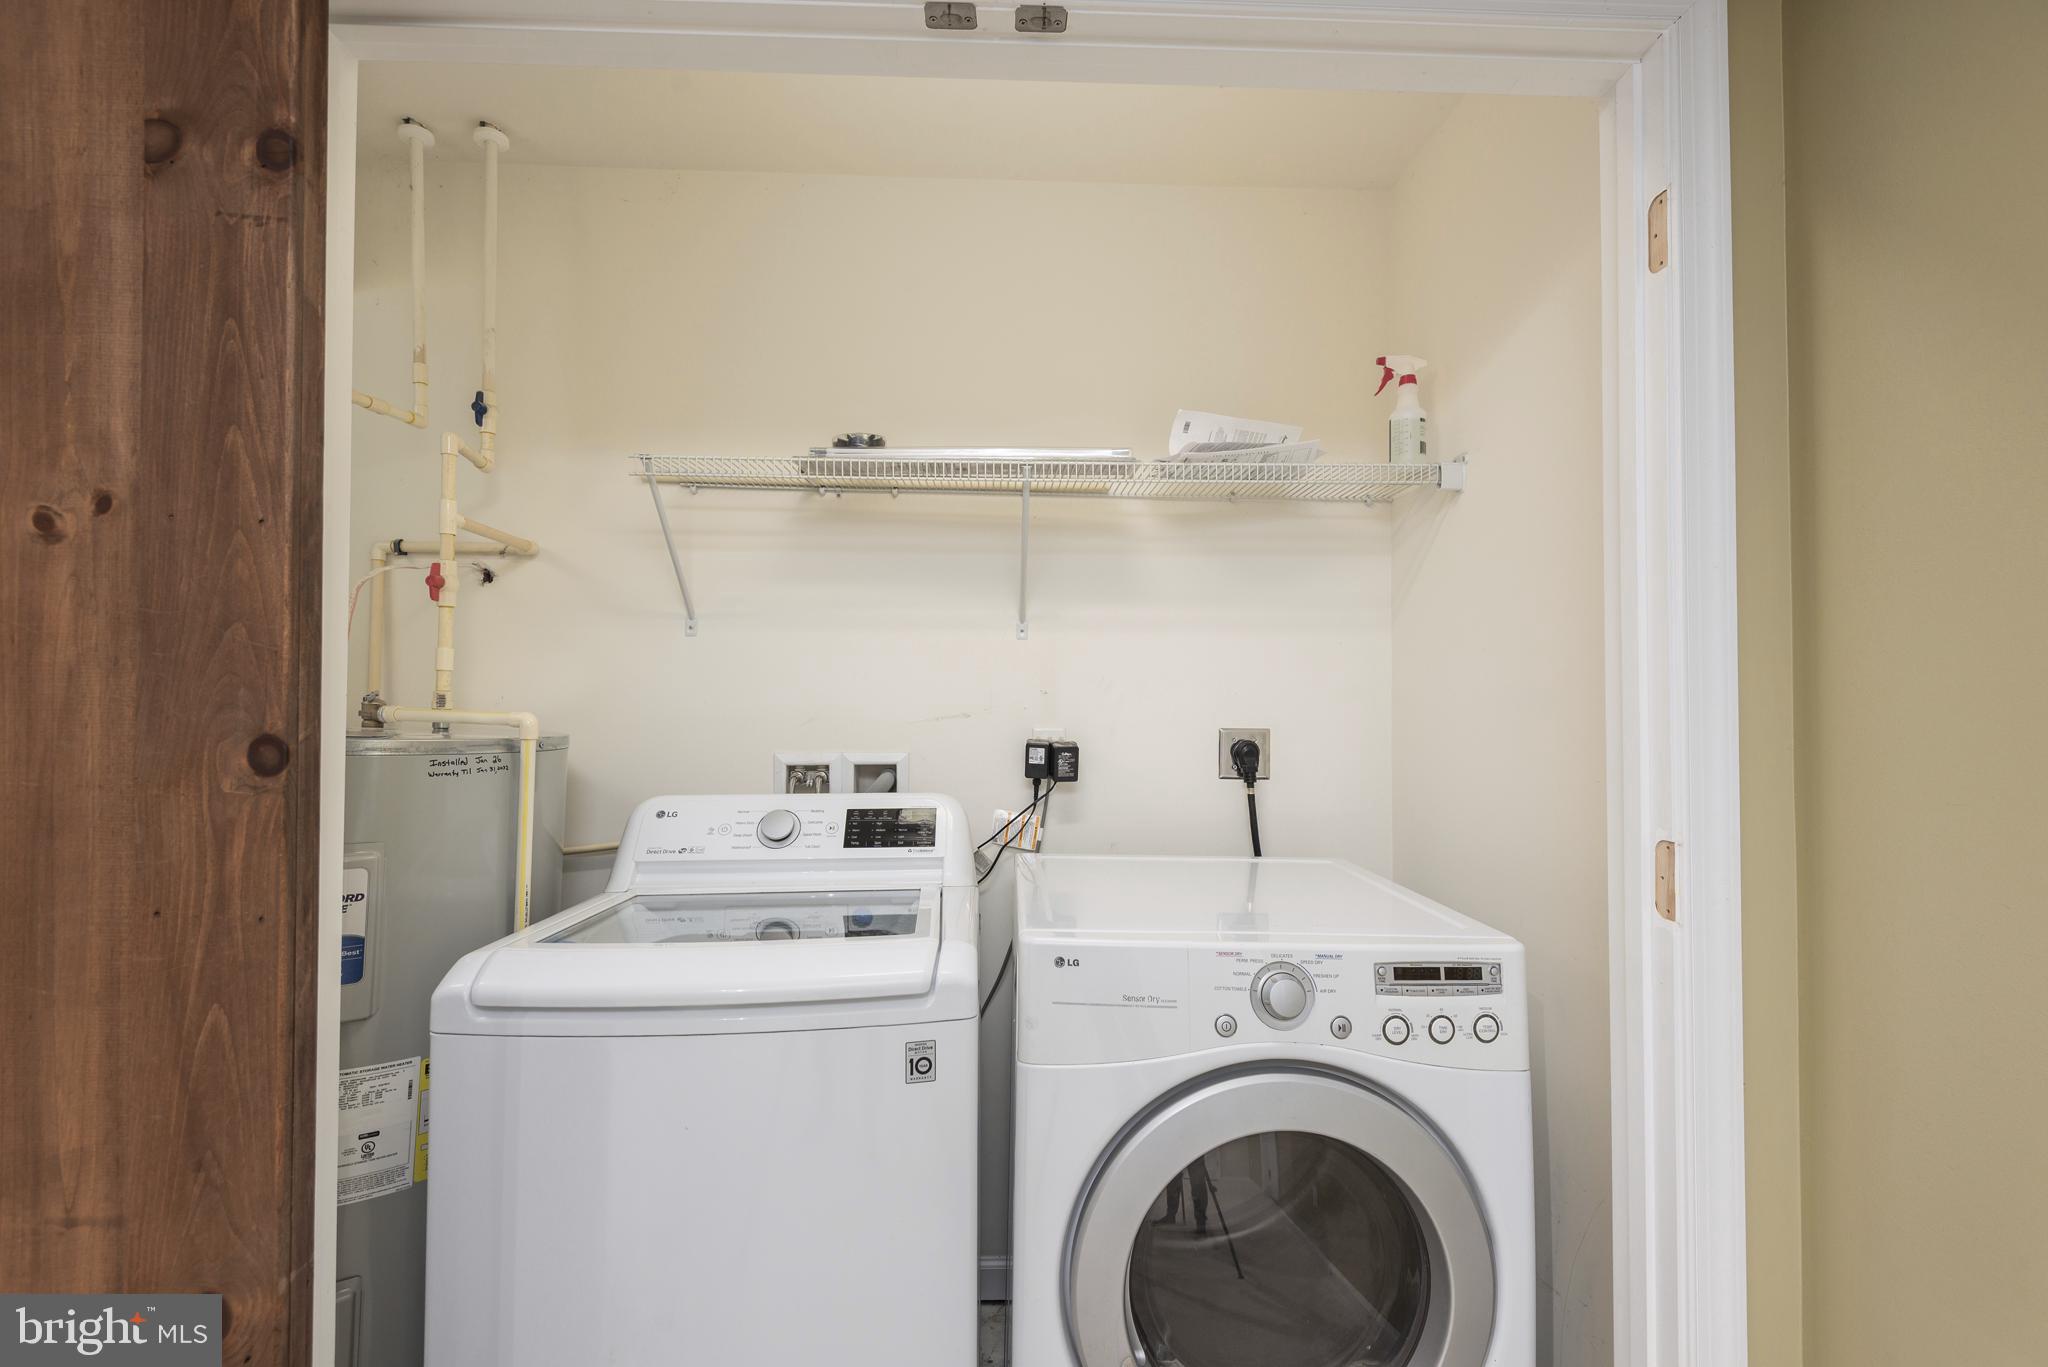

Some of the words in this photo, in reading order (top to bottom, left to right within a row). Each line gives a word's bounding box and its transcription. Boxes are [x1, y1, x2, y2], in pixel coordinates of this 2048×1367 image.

[429, 757, 468, 767] Installed
[475, 756, 488, 764] Jan
[342, 893, 365, 903] RD
[1122, 994, 1146, 1002] Sensor
[1147, 995, 1160, 1004] Dry
[909, 1057, 932, 1076] 10
